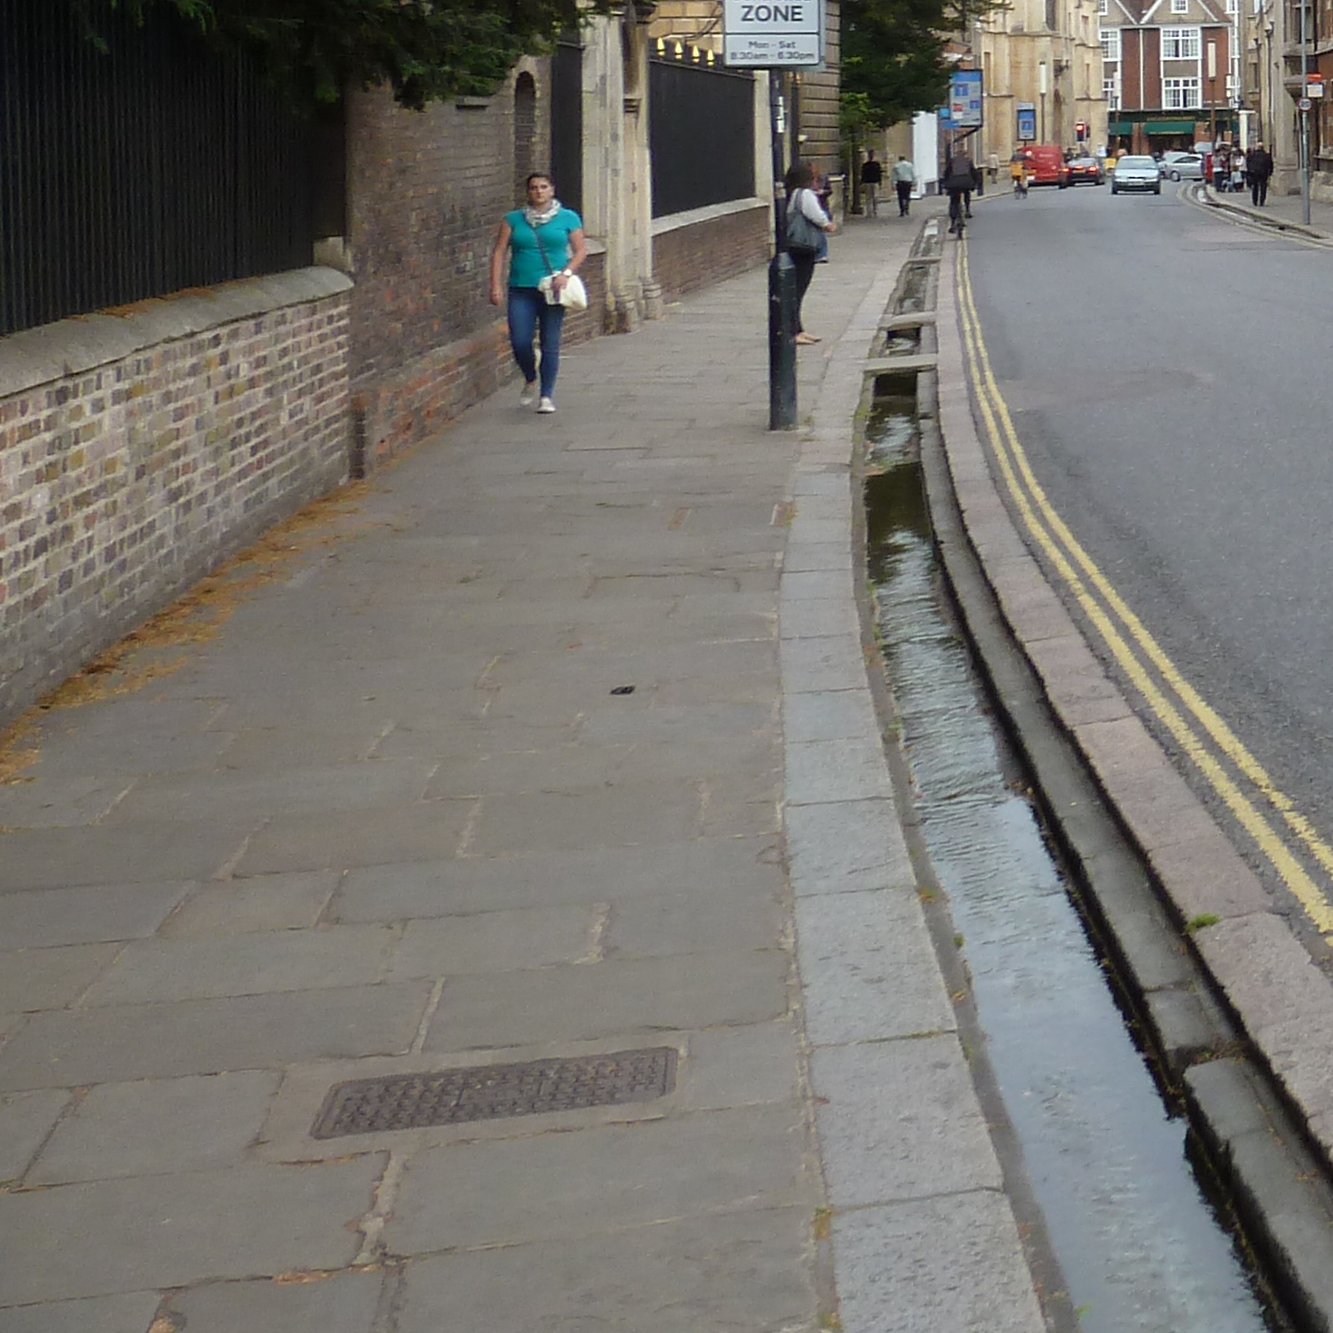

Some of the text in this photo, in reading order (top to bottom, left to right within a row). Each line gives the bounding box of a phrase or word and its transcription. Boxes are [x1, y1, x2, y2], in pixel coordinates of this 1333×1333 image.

[741, 4, 803, 22] ZONE
[748, 40, 770, 49] Mon
[778, 40, 797, 49] Sat
